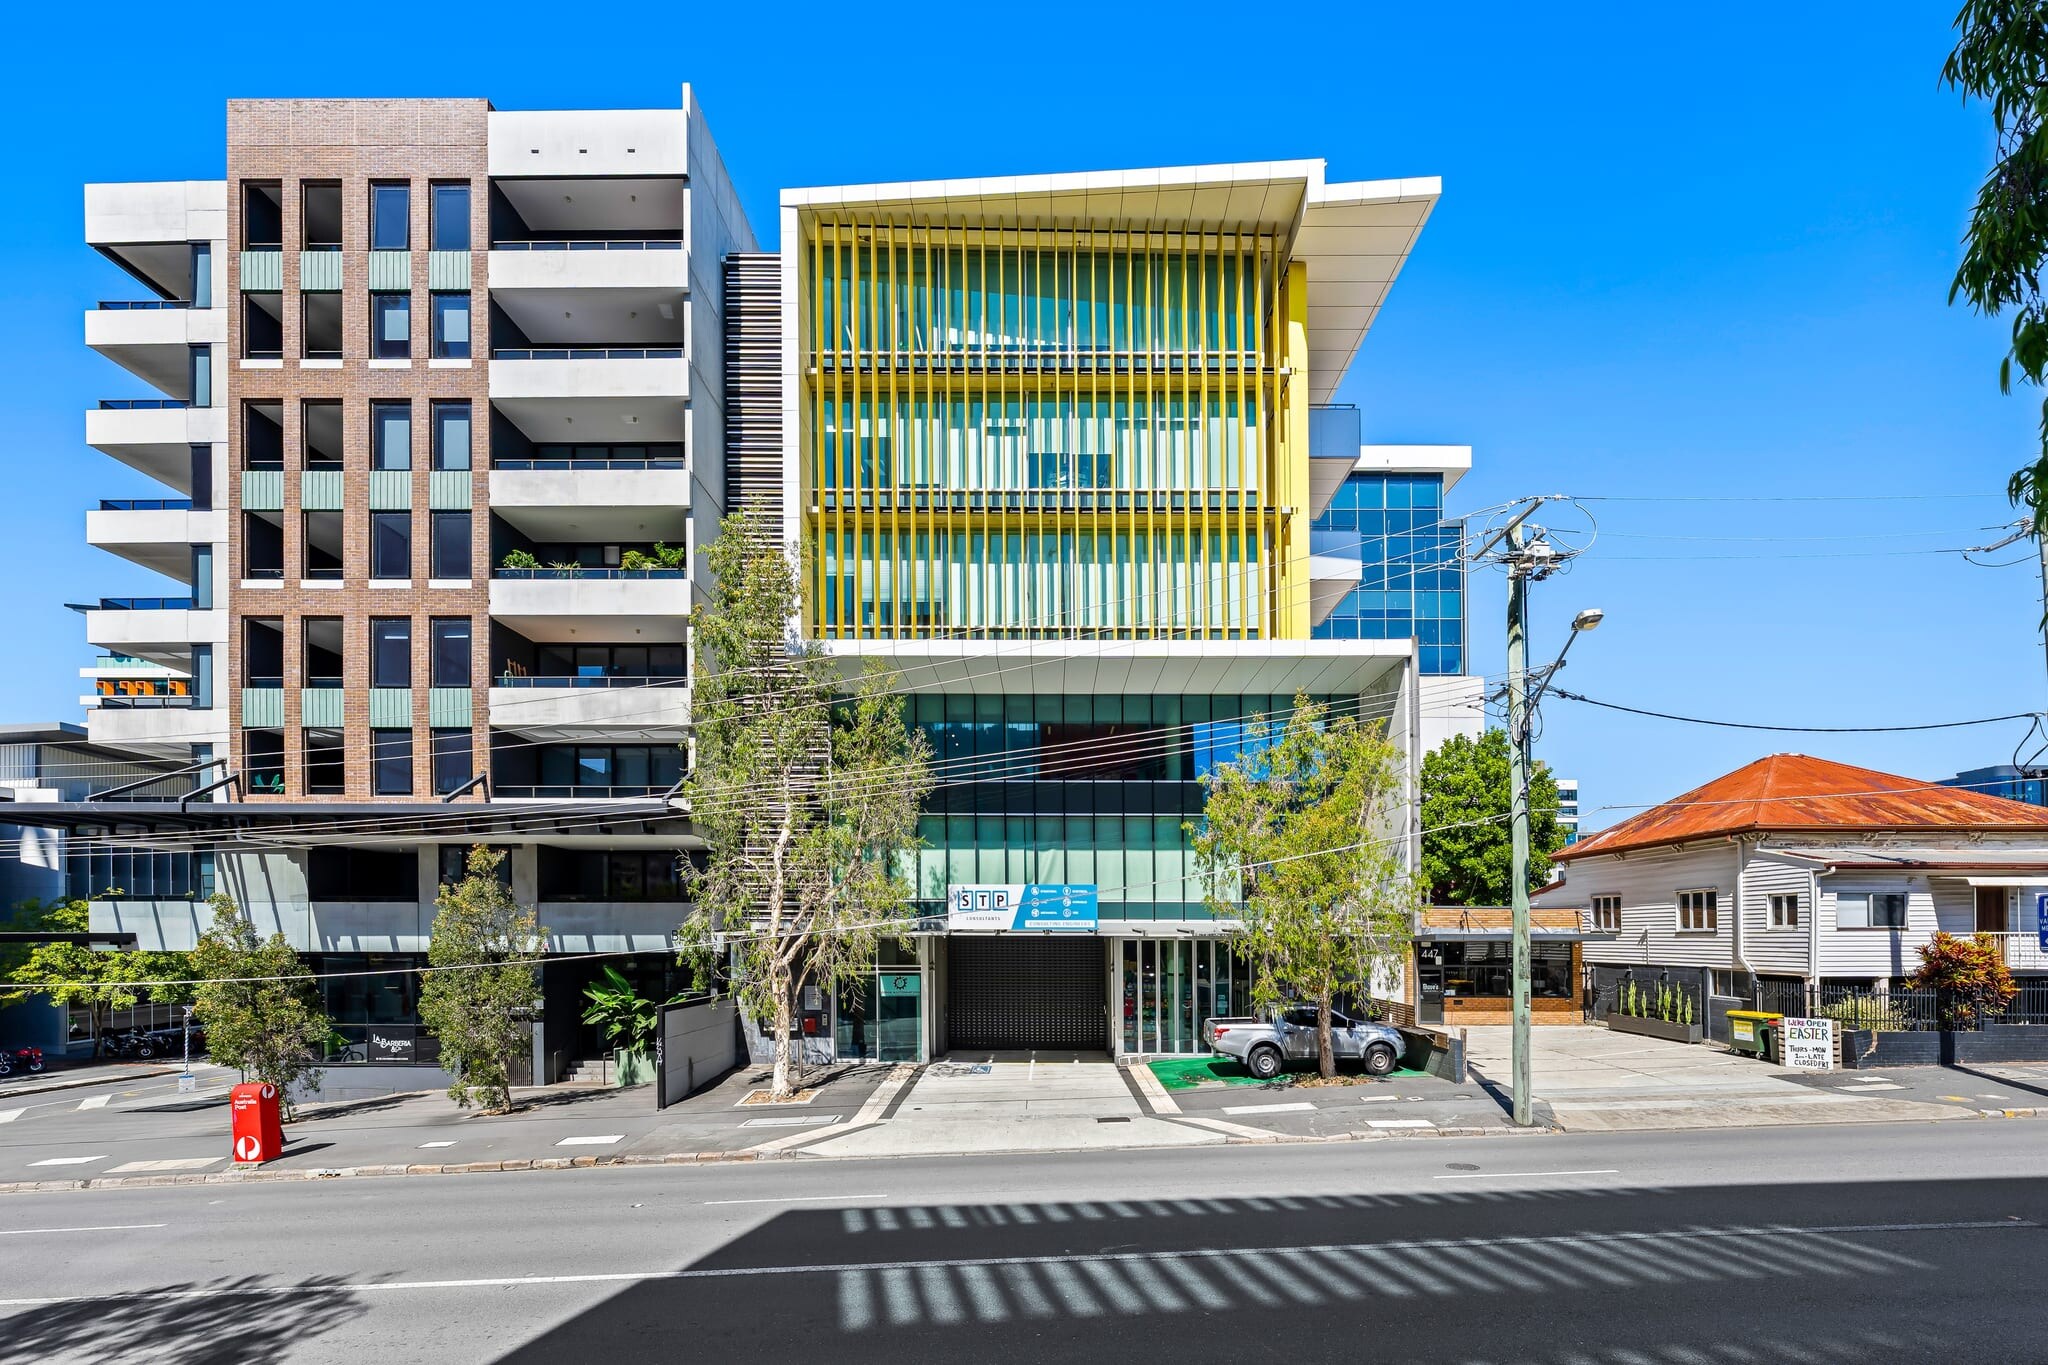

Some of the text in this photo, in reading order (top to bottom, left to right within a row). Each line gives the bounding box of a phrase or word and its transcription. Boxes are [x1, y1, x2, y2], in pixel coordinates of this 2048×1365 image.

[962, 894, 1005, 907] STP
[1421, 948, 1439, 958] 447
[1806, 1019, 1827, 1027] OPEN
[1789, 1027, 1829, 1041] EASTER
[1788, 1045, 1808, 1053] THURS
